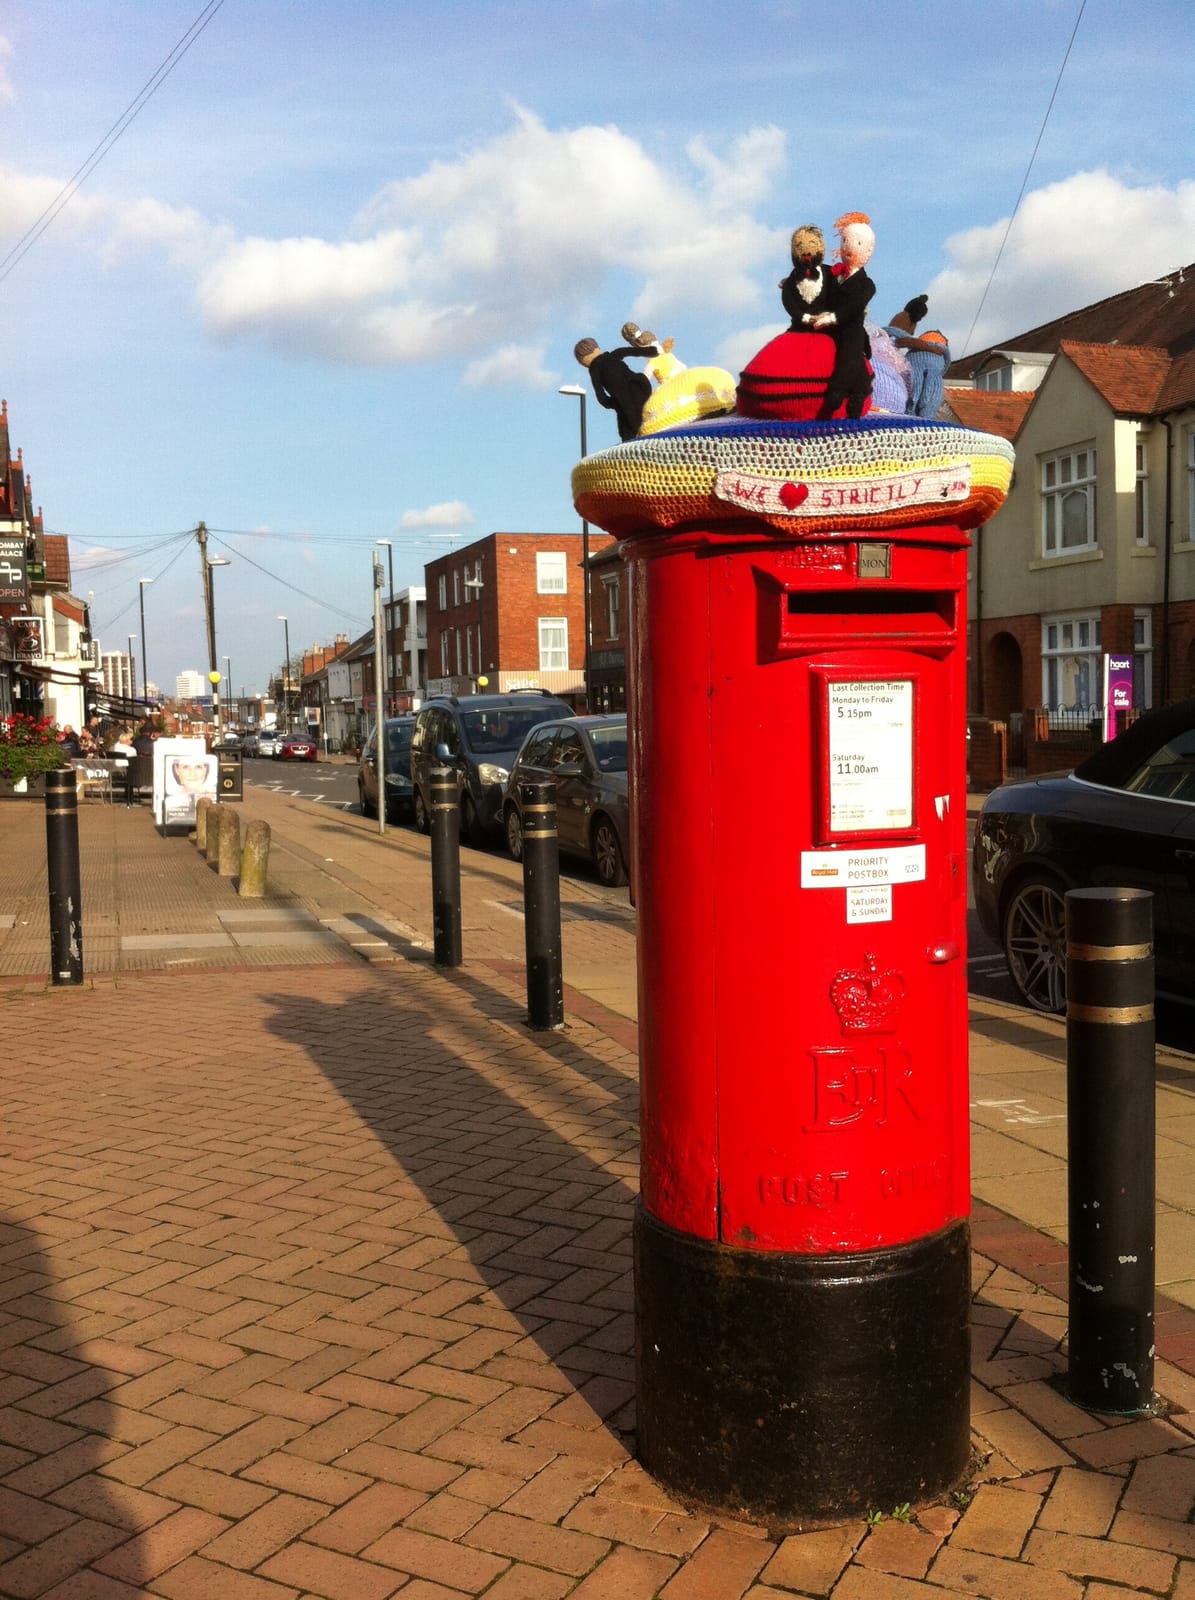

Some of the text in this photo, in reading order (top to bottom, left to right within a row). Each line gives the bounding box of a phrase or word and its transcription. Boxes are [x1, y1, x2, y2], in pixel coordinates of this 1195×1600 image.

[735, 480, 769, 504] WE
[822, 479, 923, 507] STRICTLY
[862, 559, 885, 568] MON
[832, 682, 905, 692] Last Collection Time
[1114, 689, 1126, 697] For
[832, 697, 860, 705] Monday
[871, 696, 893, 704] Friday
[1114, 698, 1129, 706] sale
[832, 754, 864, 762] Saturday
[848, 857, 888, 867] PRIORITY
[848, 869, 888, 879] POSTBOX
[851, 898, 888, 907] SATURDAY
[859, 907, 888, 916] SUNDAY
[757, 1171, 849, 1205] POST
